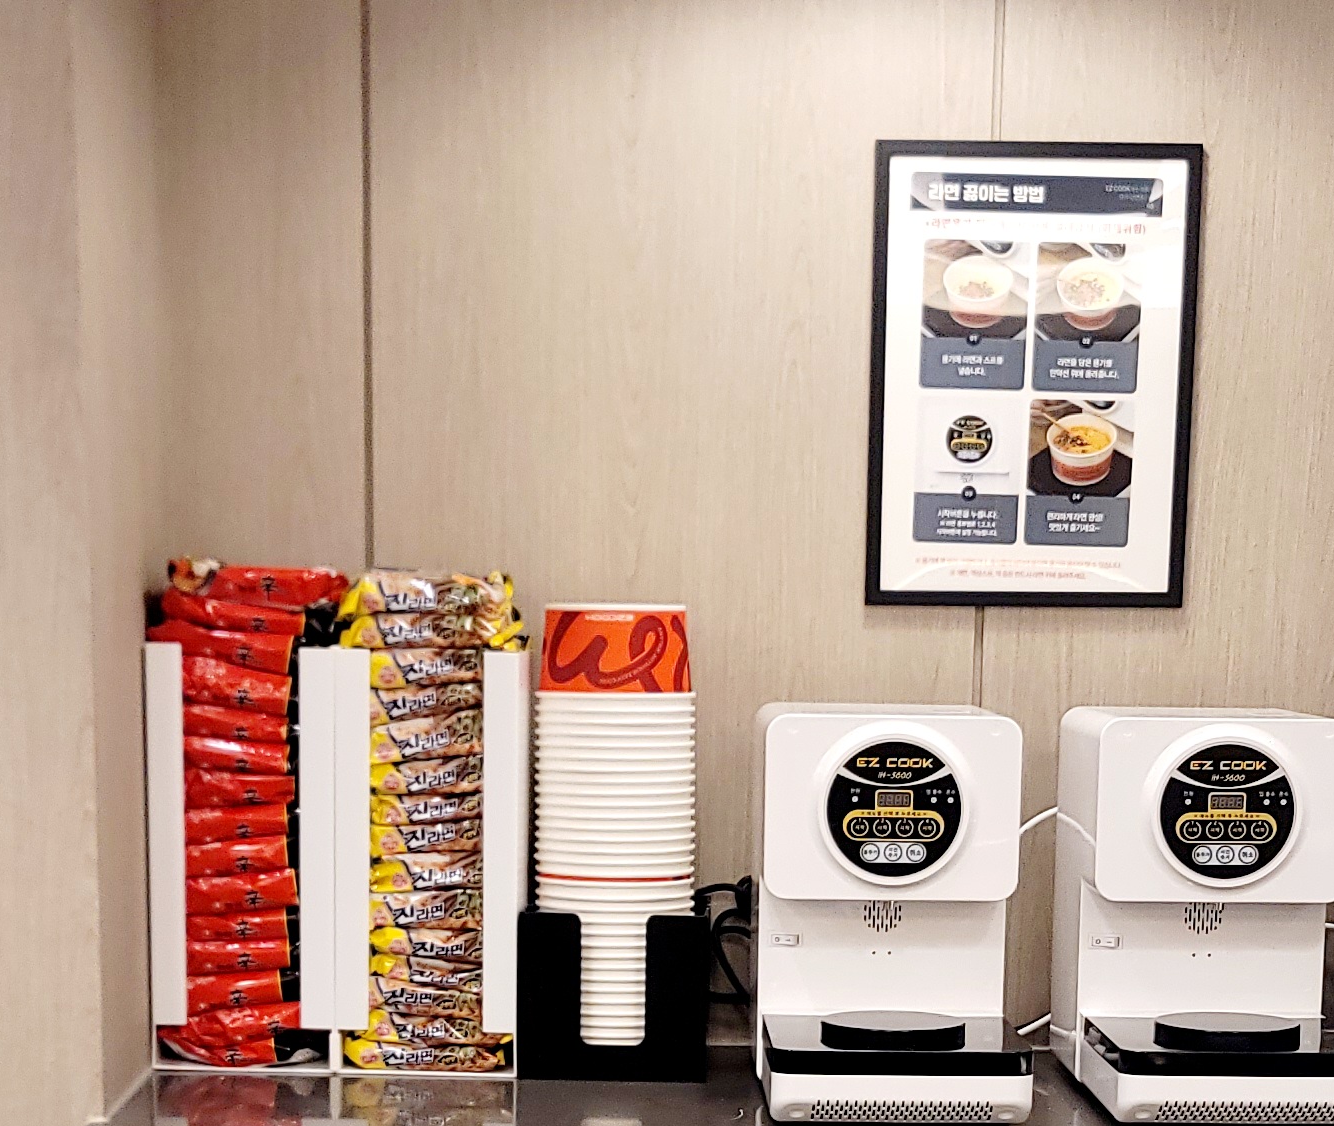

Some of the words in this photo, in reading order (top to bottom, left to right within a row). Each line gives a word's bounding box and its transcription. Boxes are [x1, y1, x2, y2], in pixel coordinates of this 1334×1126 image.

[927, 182, 961, 201] 라면
[962, 183, 1010, 203] 끓이는
[1013, 184, 1044, 204] 방법
[261, 575, 278, 602] 辛
[385, 693, 436, 718] 진라면
[398, 730, 449, 757] 진라면
[856, 757, 880, 768] EZ
[886, 757, 934, 768] COOK
[1189, 760, 1214, 770] EZ
[1219, 760, 1267, 771] COOK
[407, 769, 455, 793] 진라면
[406, 801, 456, 822] 진라면
[404, 826, 455, 850] 진라면
[393, 904, 444, 926] 진라면
